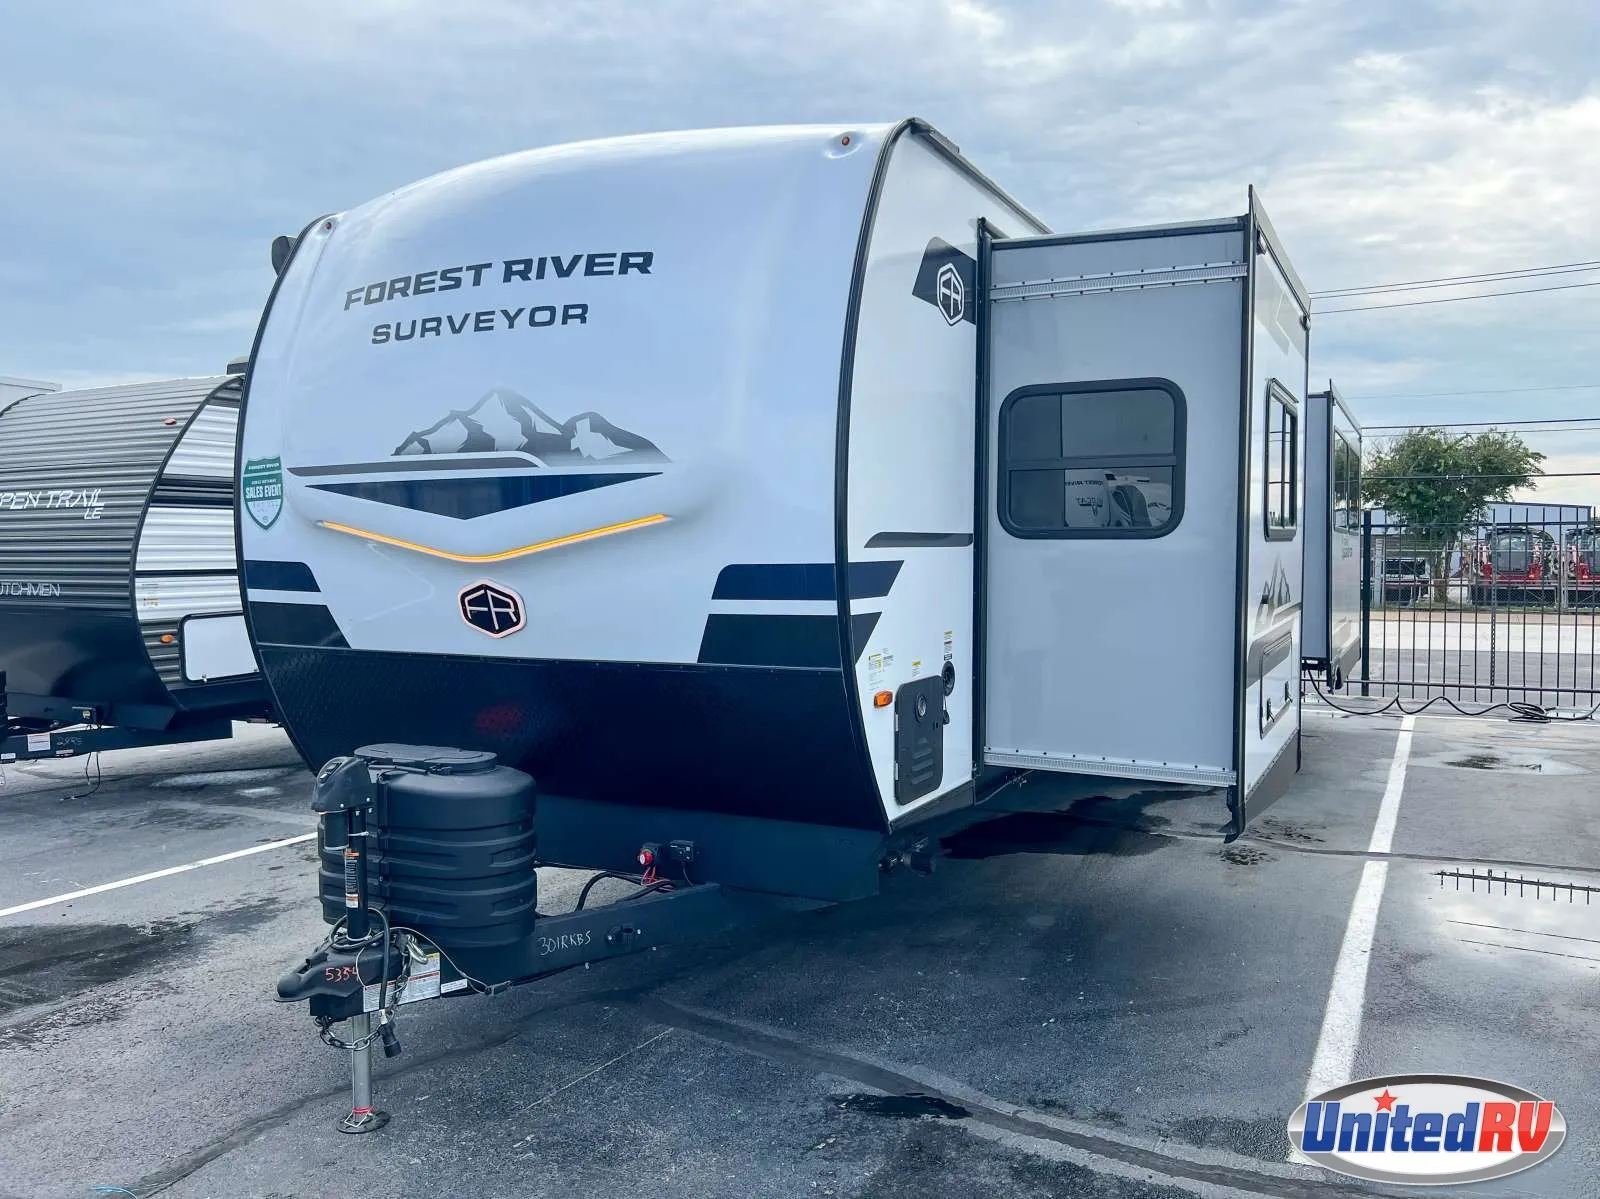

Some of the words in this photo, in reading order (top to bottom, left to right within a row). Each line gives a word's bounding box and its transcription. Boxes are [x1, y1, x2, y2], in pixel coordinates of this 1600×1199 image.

[343, 262, 492, 312] FOREST
[502, 251, 654, 284] RIVER
[371, 303, 588, 345] SURVEYOR
[46, 488, 105, 508] TRAIL
[246, 486, 263, 498] SALES
[264, 484, 281, 497] EVENT
[83, 507, 104, 520] LE
